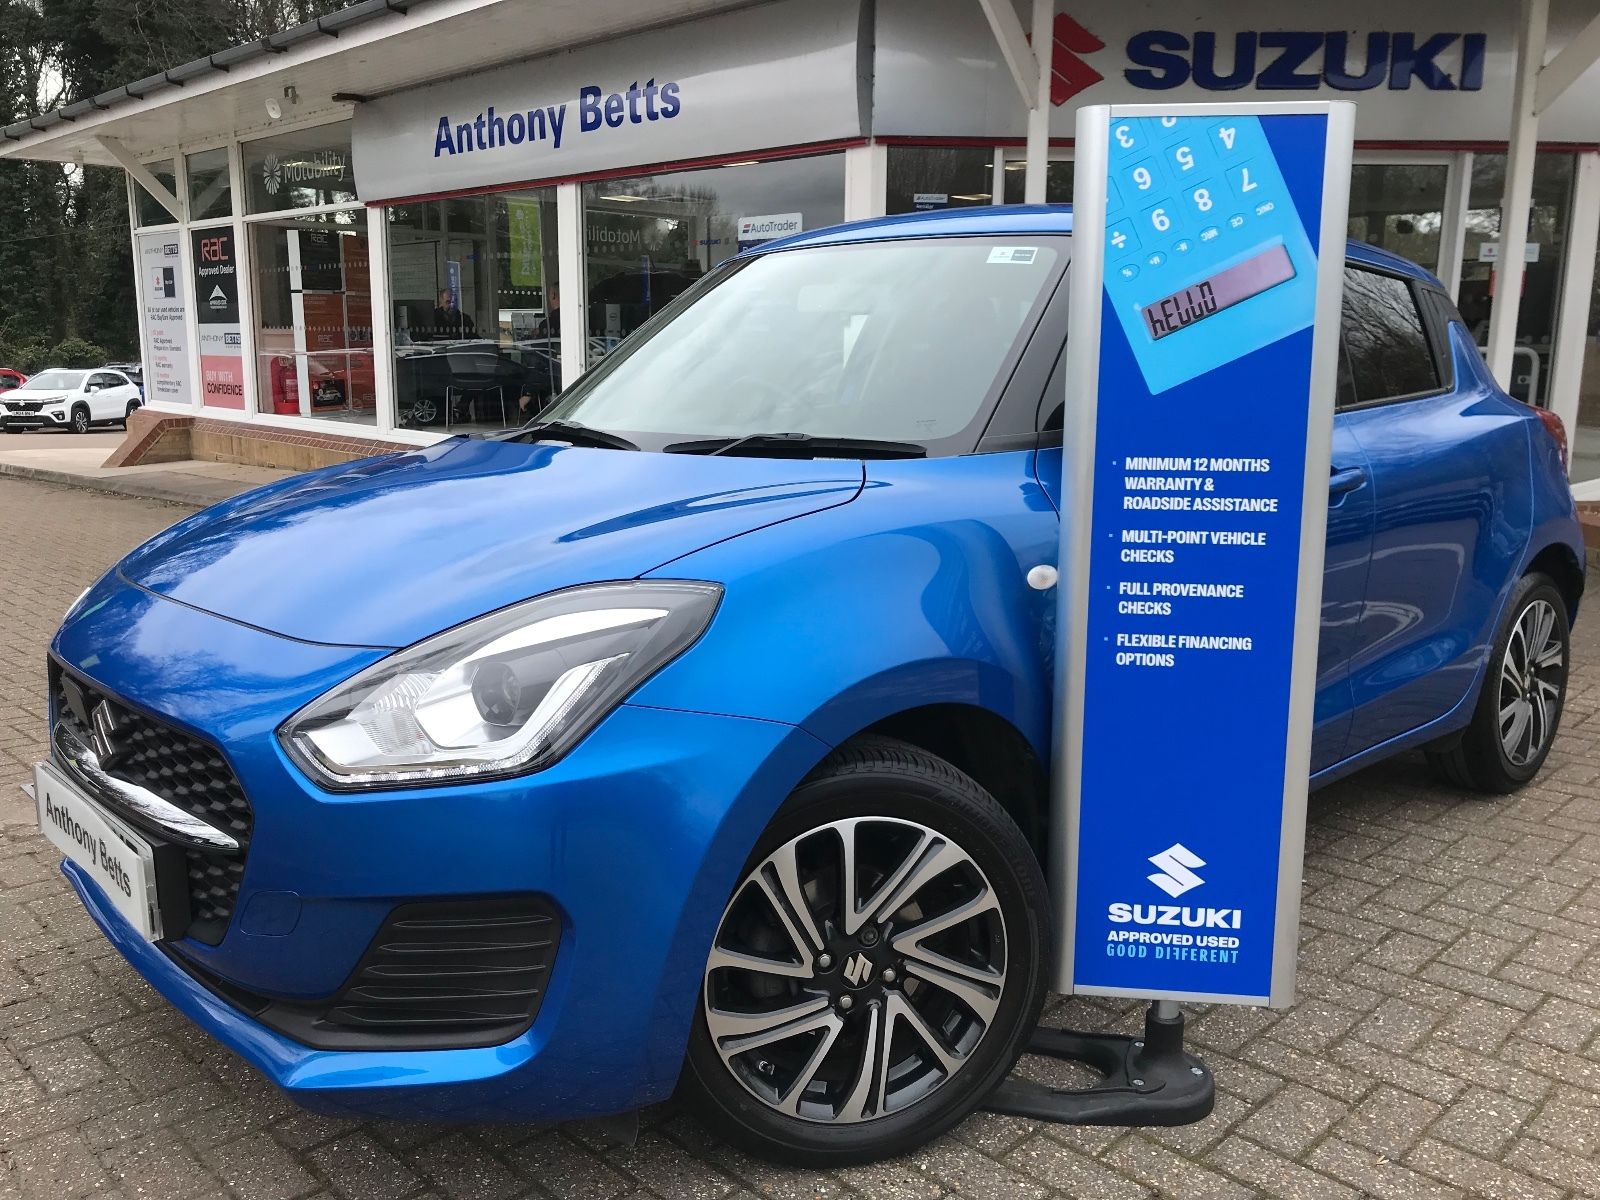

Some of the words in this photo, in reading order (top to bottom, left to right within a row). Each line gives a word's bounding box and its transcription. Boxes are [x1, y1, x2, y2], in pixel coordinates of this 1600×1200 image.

[1124, 30, 1487, 92] SUZUKI
[434, 104, 567, 157] Anthony
[580, 78, 681, 133] Betts
[1115, 125, 1134, 148] 3
[1218, 127, 1236, 150] 4
[1175, 146, 1195, 171] 5
[284, 150, 345, 184] Motability
[1241, 168, 1258, 192] 7
[1193, 188, 1213, 212] 8
[750, 220, 798, 233] AutoTrader
[199, 265, 219, 278] Approved
[220, 264, 235, 274] Dealer
[225, 334, 241, 344] BETTS
[206, 370, 217, 381] BUY
[217, 371, 233, 382] WITH
[207, 383, 243, 396] CONFIDENCE
[1125, 457, 1191, 471] MINIMUM
[1193, 458, 1208, 471] 12
[1210, 458, 1270, 472] MONTHS
[1125, 477, 1202, 491] WARRANTY
[1204, 478, 1214, 491] &
[1123, 497, 1191, 511] ROADSIDE
[1193, 497, 1278, 512] ASSISTANCE
[1122, 530, 1209, 544] MULTI-POINT
[1211, 532, 1267, 546] VEHICLE
[1121, 549, 1174, 563] CHECKS
[1119, 582, 1150, 596] FULL
[1153, 583, 1244, 598] PROVENANCE
[1118, 601, 1171, 615] CHECKS
[1117, 634, 1176, 648] FLEXIBLE
[1178, 635, 1252, 650] FINANCING
[1116, 653, 1174, 667] OPTIONS
[46, 792, 96, 865] Anthony
[99, 837, 132, 898] Betts
[1108, 902, 1242, 929] SUZUKI
[1107, 930, 1193, 946] APPROVED
[1196, 935, 1239, 949] USED
[1107, 943, 1147, 958] GOOD
[1155, 947, 1238, 964] DIFFERENT
